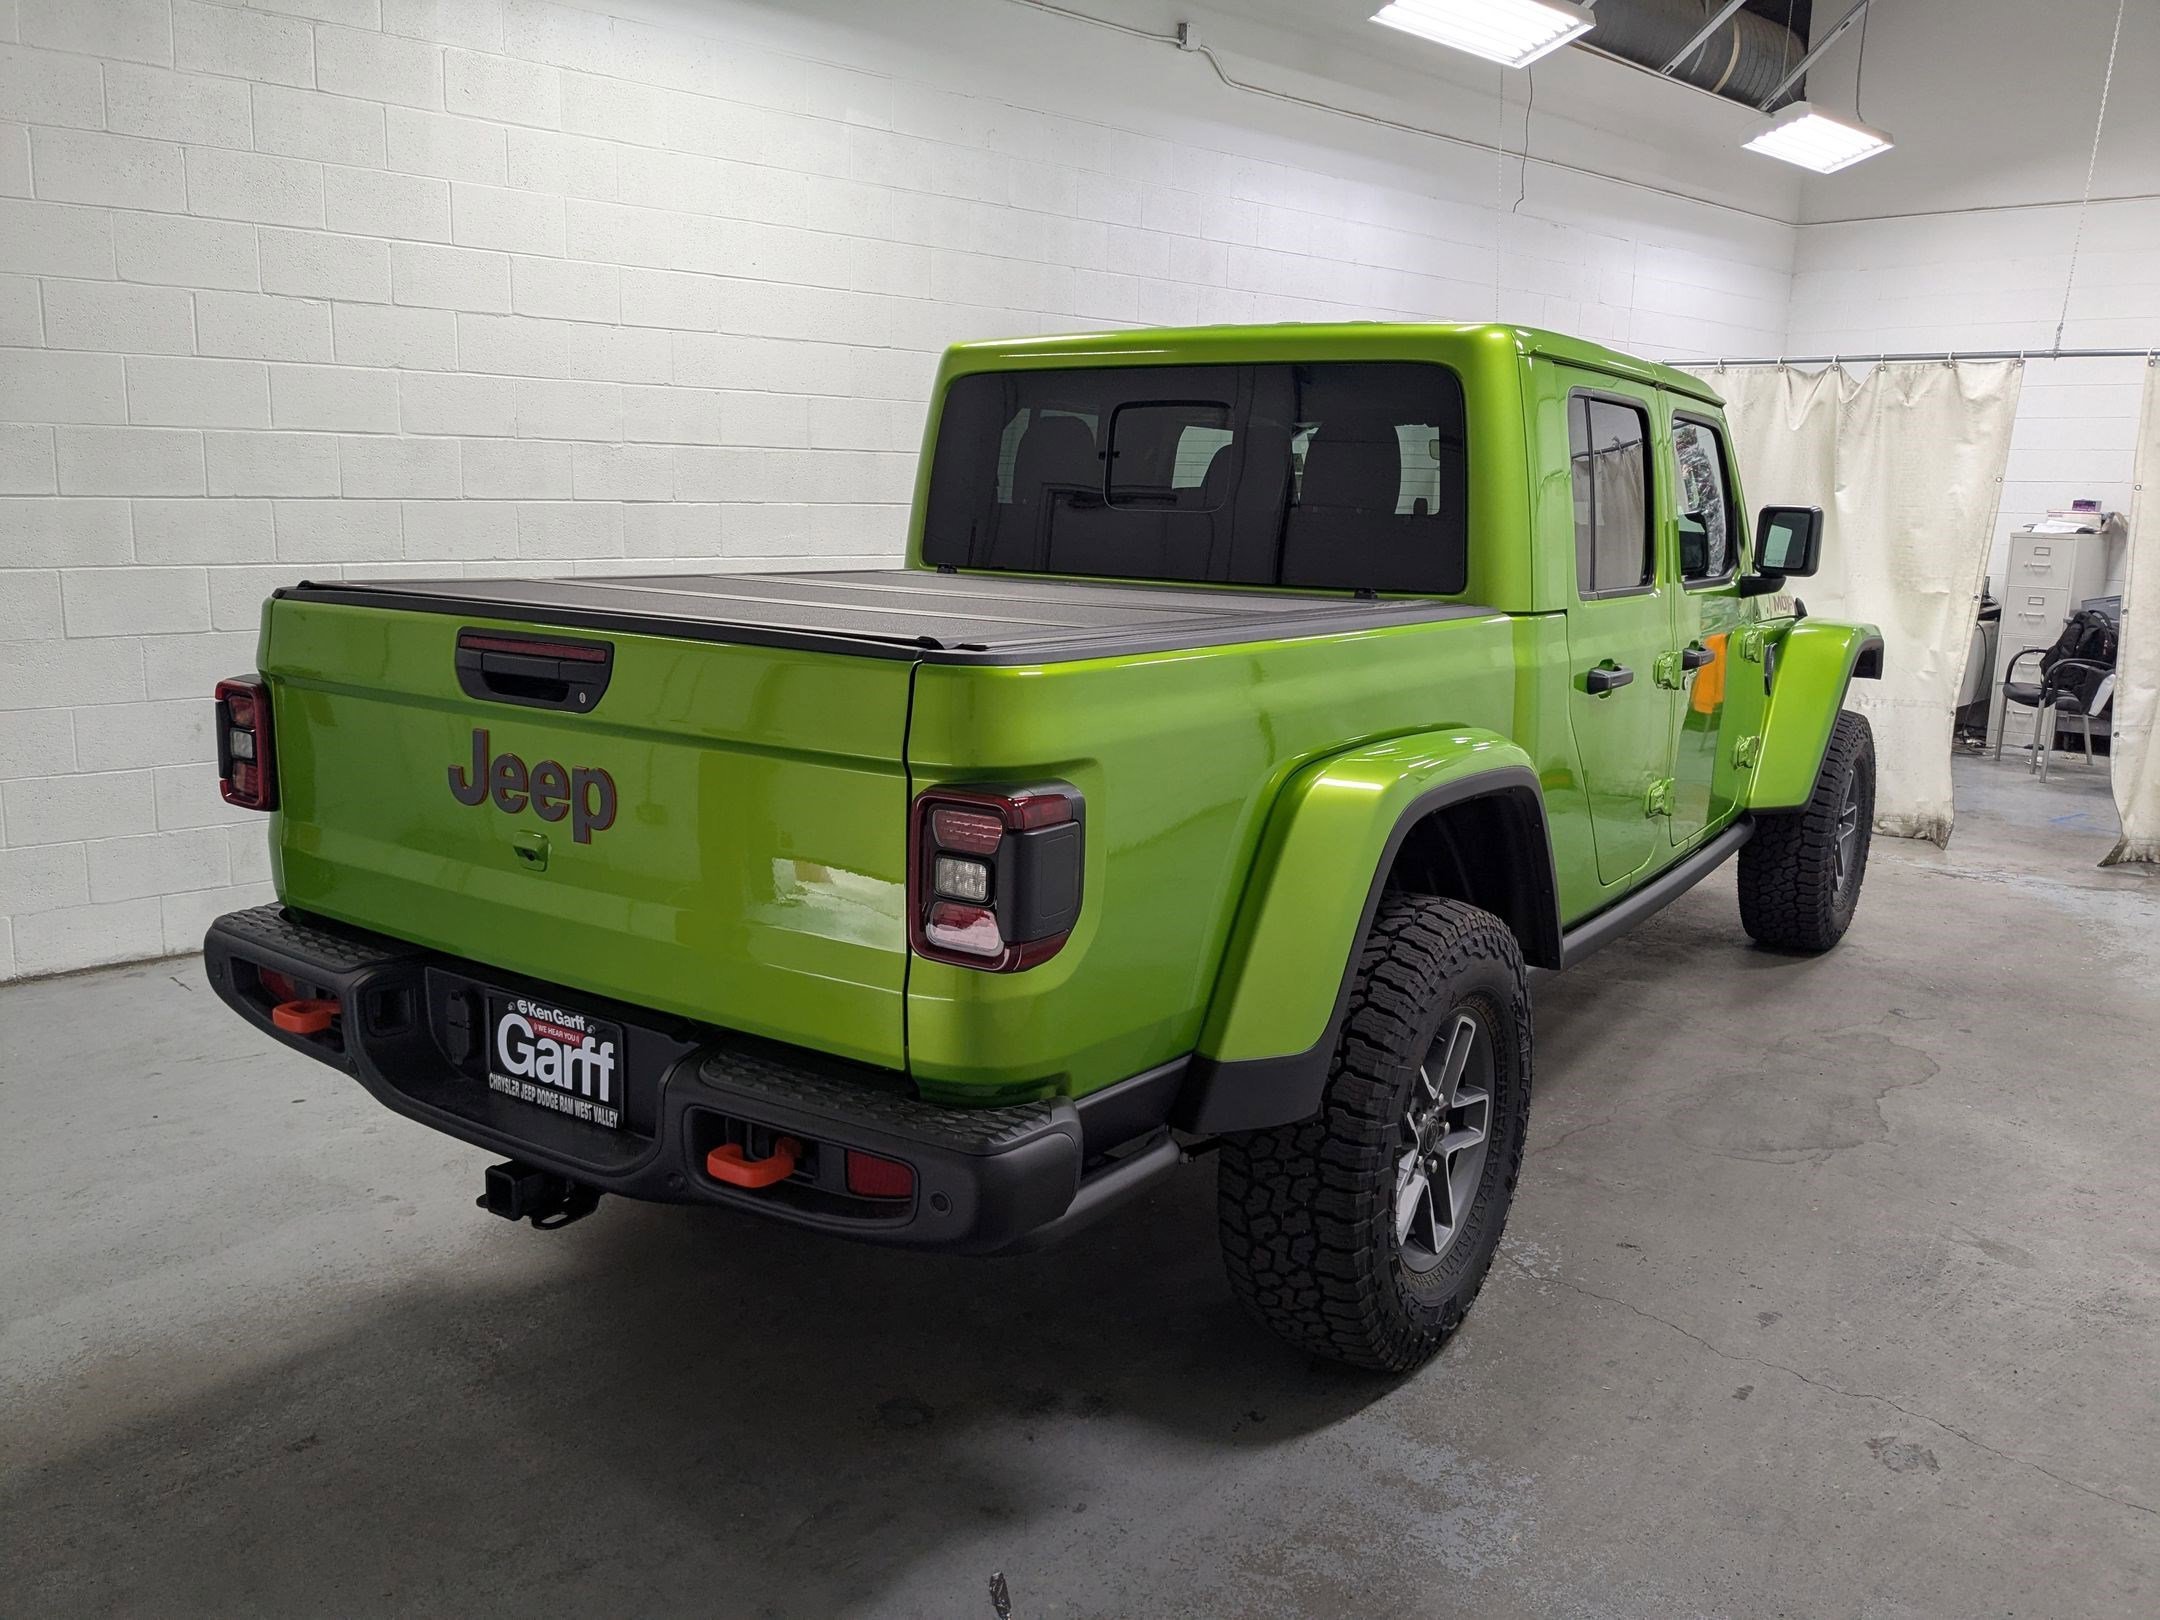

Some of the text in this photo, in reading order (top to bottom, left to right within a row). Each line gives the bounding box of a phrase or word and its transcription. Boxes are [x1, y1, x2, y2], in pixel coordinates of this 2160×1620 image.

[448, 728, 617, 844] Jeep
[527, 1002, 585, 1031] Ken Garff
[538, 1024, 576, 1042] WE HEAR YOU
[497, 1013, 615, 1103] Garff
[489, 1072, 619, 1129] CHRYSLER JEEP DODGE RAM WEST VALLEY
